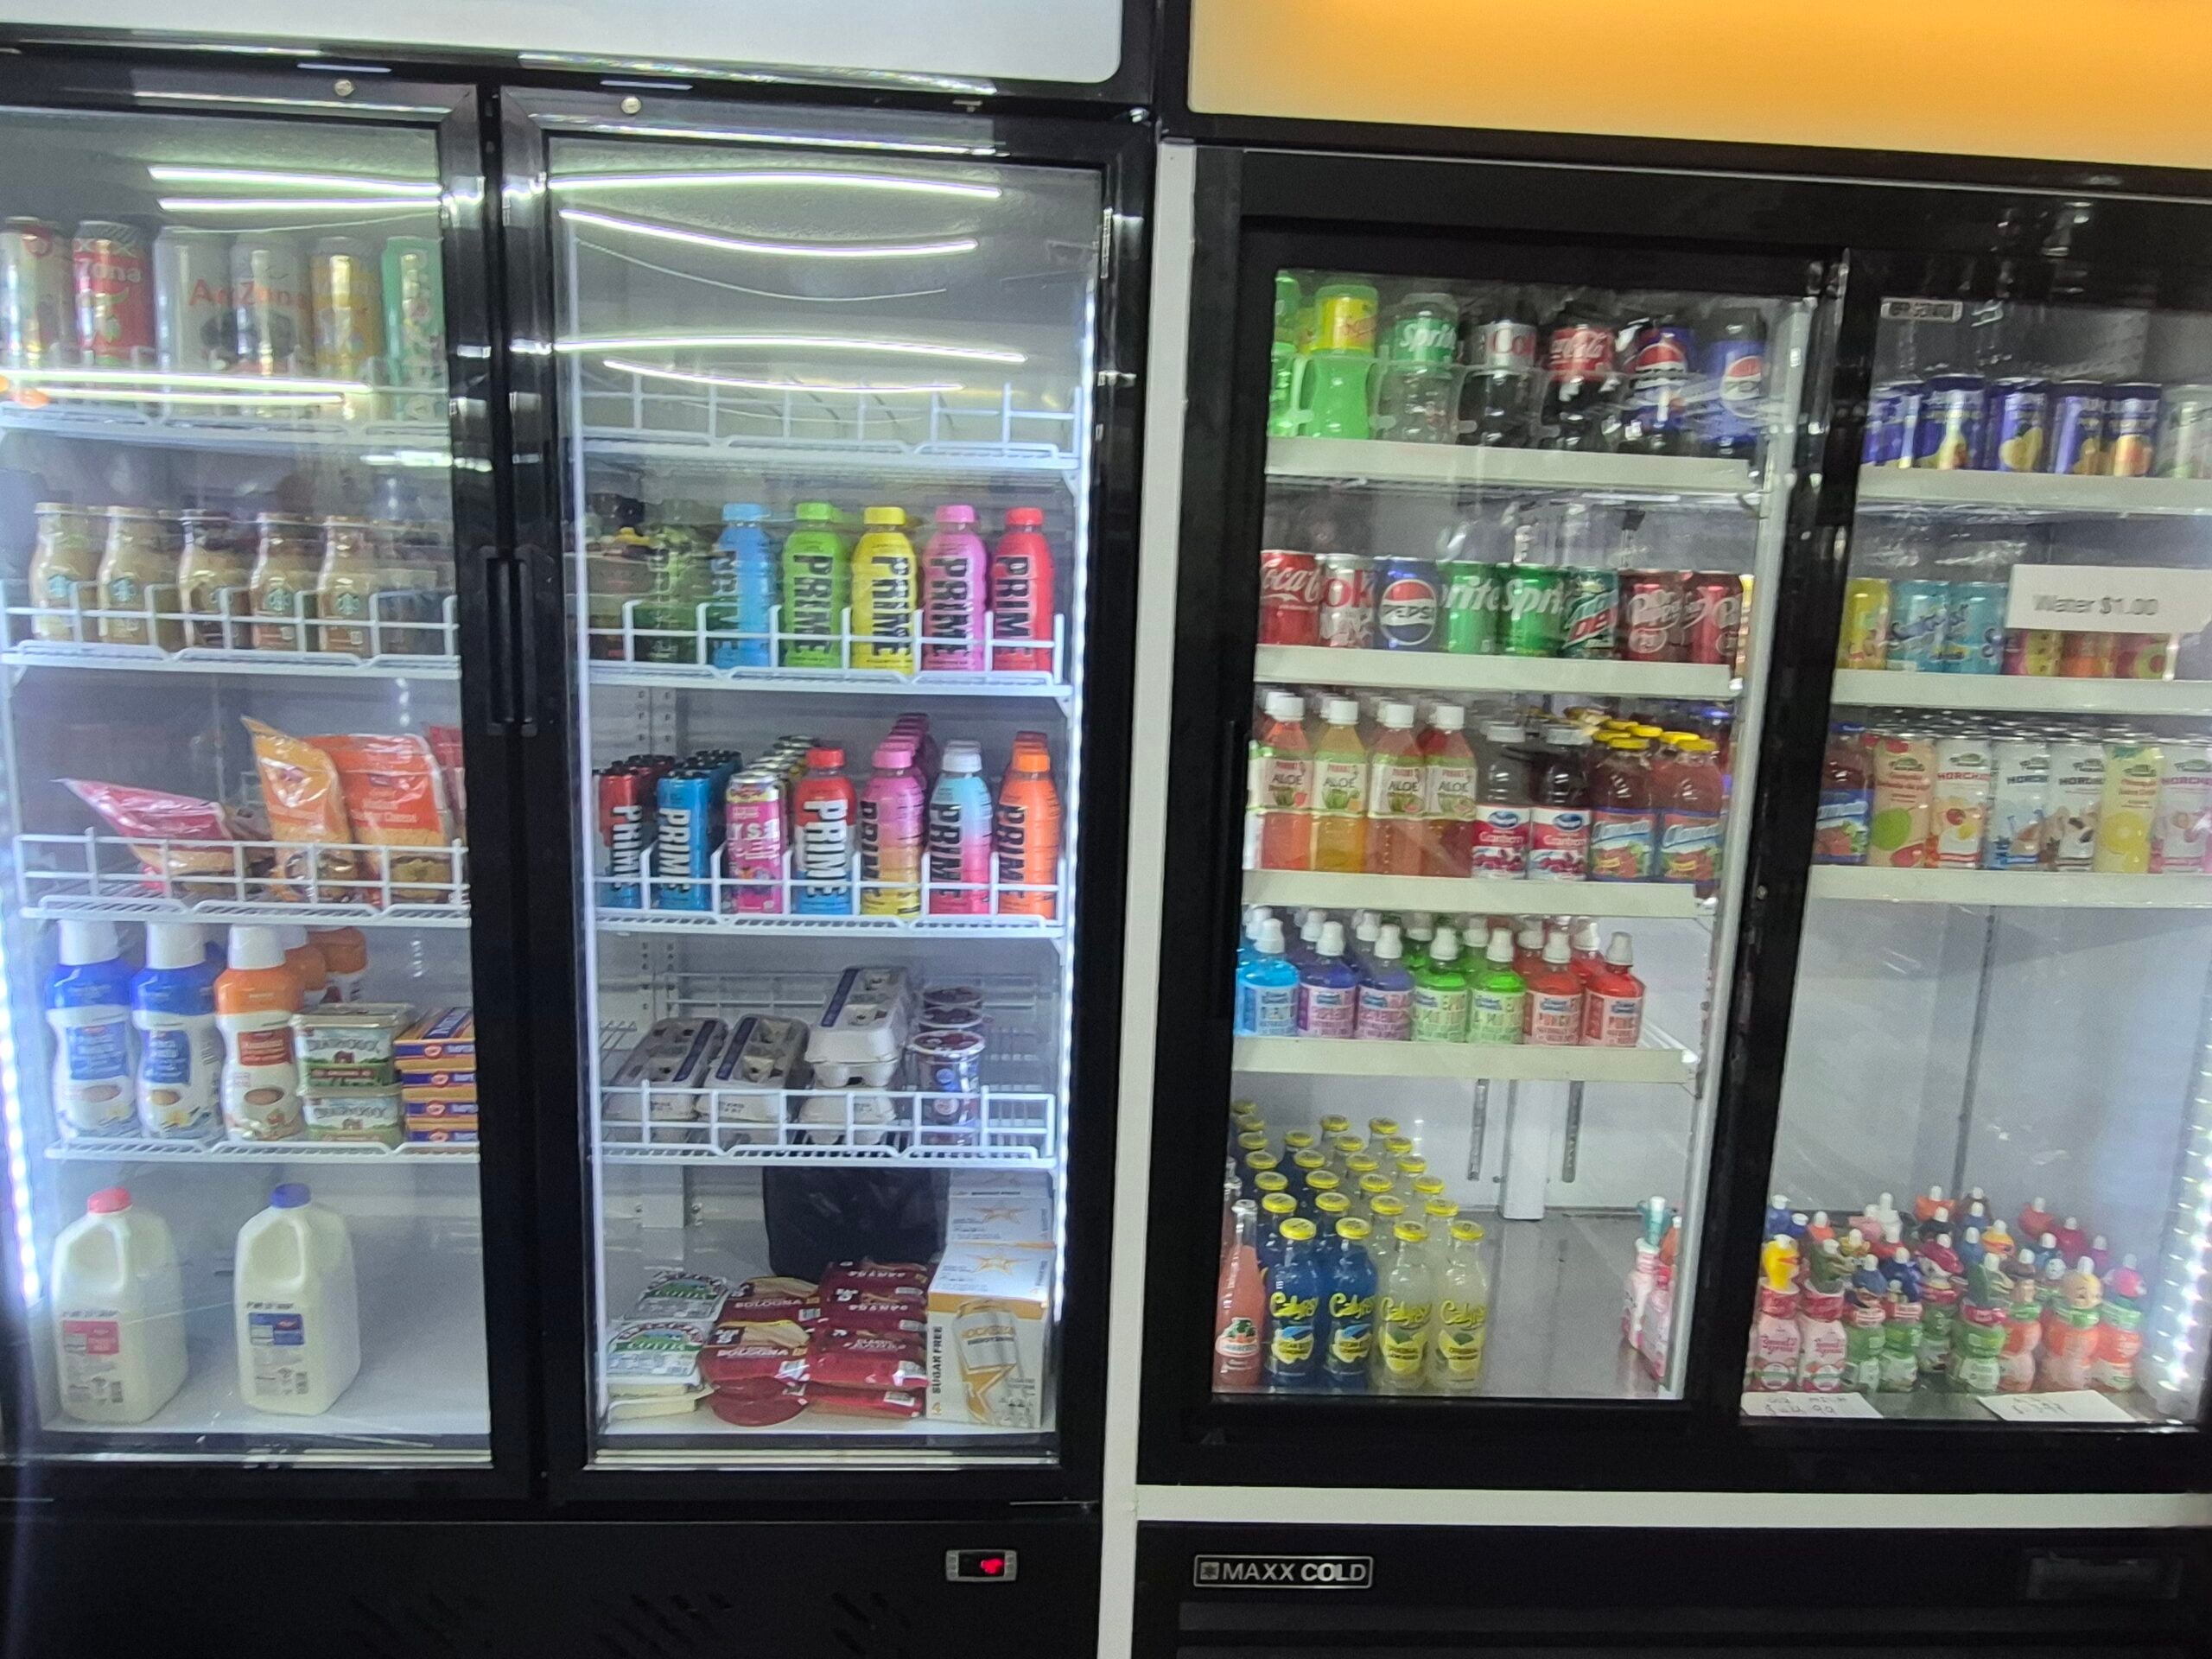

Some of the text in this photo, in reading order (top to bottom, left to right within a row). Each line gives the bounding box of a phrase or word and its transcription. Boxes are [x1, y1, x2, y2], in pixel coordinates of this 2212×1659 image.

[871, 556, 910, 656] PRIME
[1223, 1562, 1367, 1582] MAXX COLD
